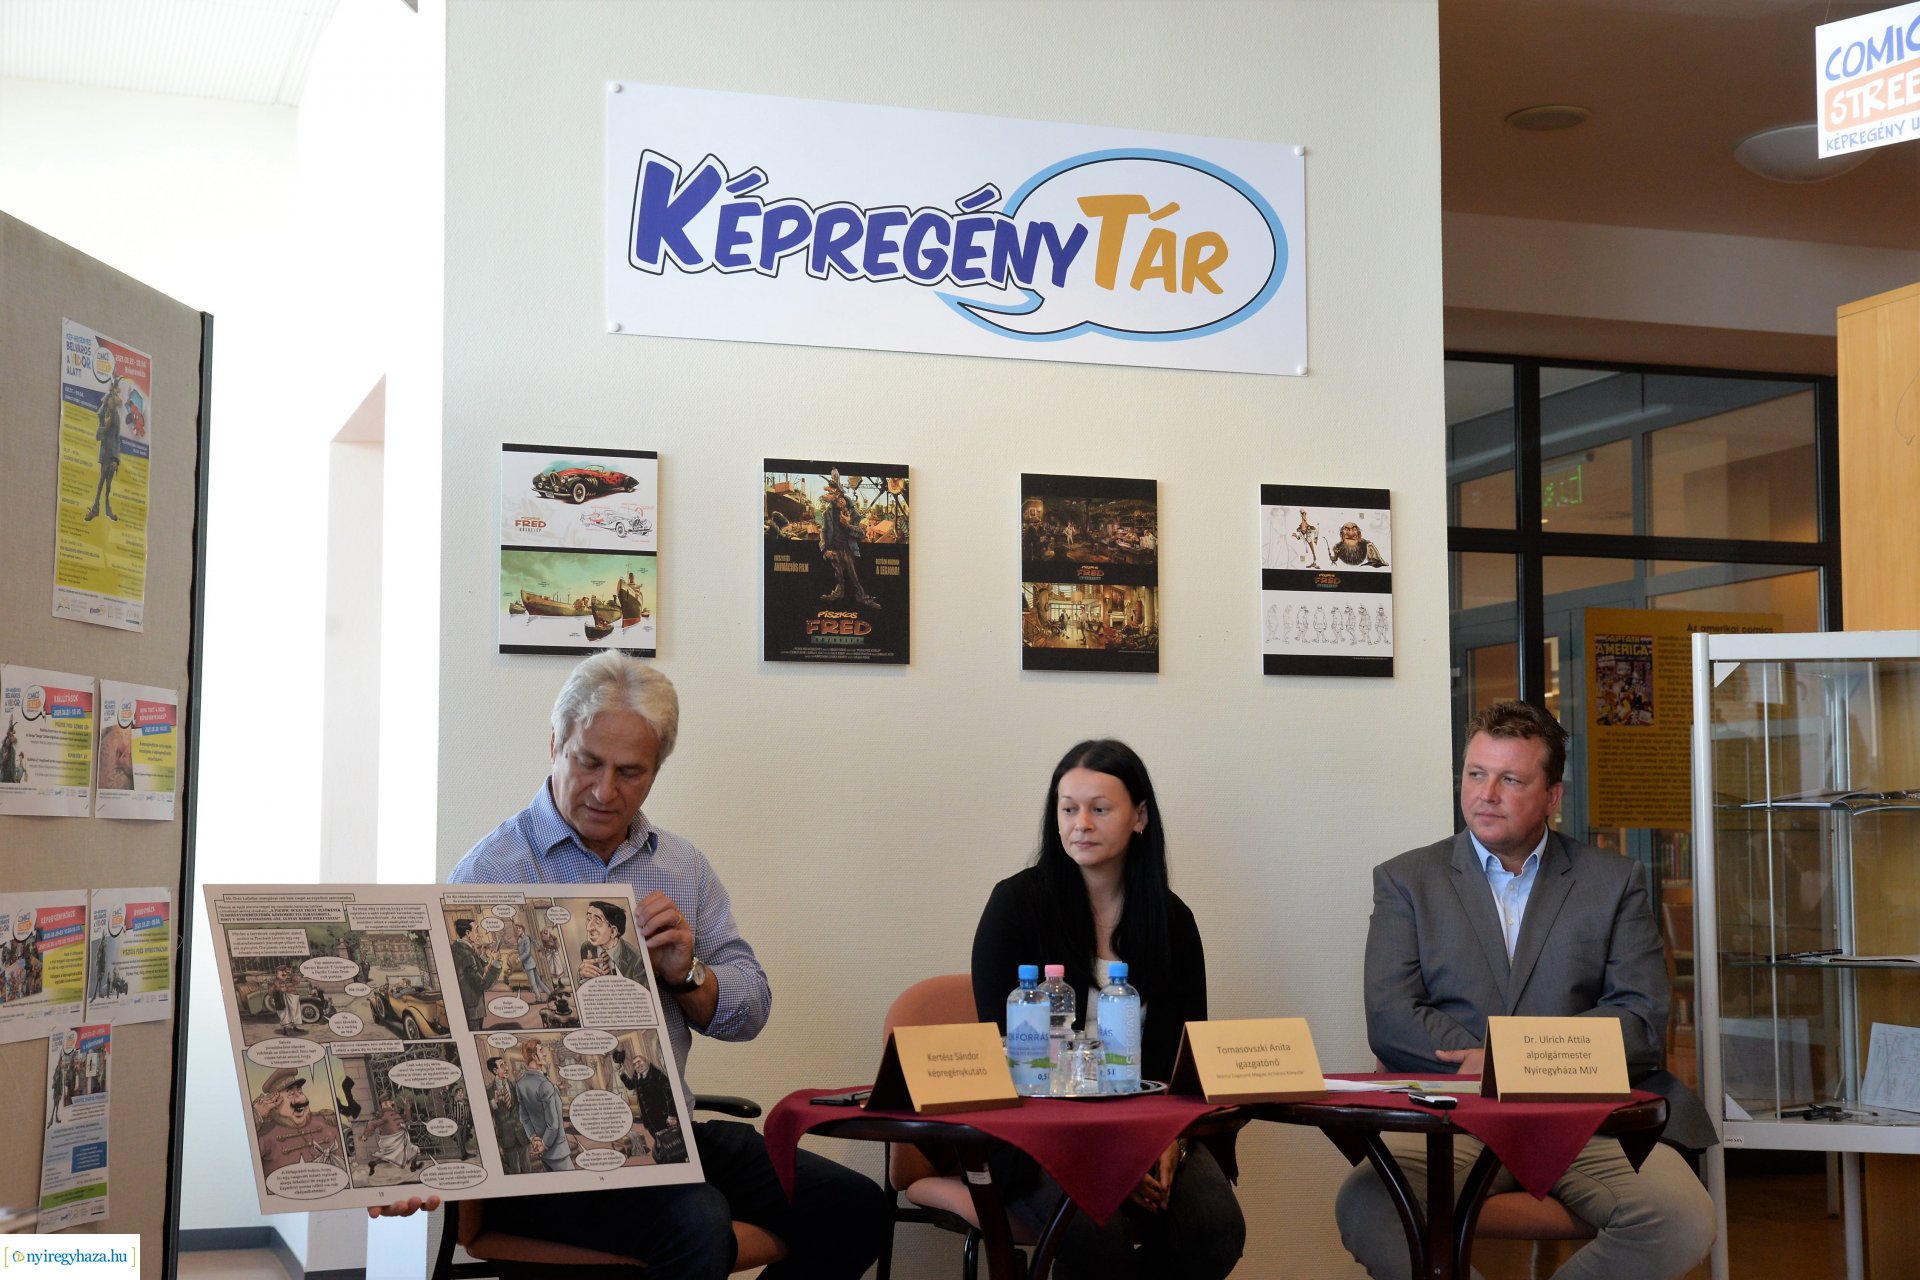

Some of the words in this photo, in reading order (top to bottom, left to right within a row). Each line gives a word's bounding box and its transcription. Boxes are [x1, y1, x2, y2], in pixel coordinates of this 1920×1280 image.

[1826, 119, 1906, 152] KÉPREGÉNY
[515, 519, 547, 528] FRED
[1077, 569, 1105, 577] FRED
[817, 611, 859, 619] PISZKOS
[806, 619, 872, 636] FRED
[1596, 643, 1650, 656] AMERICA
[1015, 1031, 1049, 1042] FORRÁS
[1523, 1035, 1537, 1044] Dr.
[1539, 1035, 1565, 1044] Ulrich
[1567, 1035, 1591, 1044] Attila
[1216, 1042, 1268, 1055] Tomasovszki
[1269, 1042, 1291, 1052] Anita
[927, 1052, 954, 1062] Kertész
[954, 1051, 979, 1061] Sándor
[1526, 1050, 1592, 1061] alpolgármester
[927, 1067, 988, 1079] képregénykutató
[1524, 1065, 1578, 1077] Nyíregyháza
[1579, 1066, 1599, 1075] MJV
